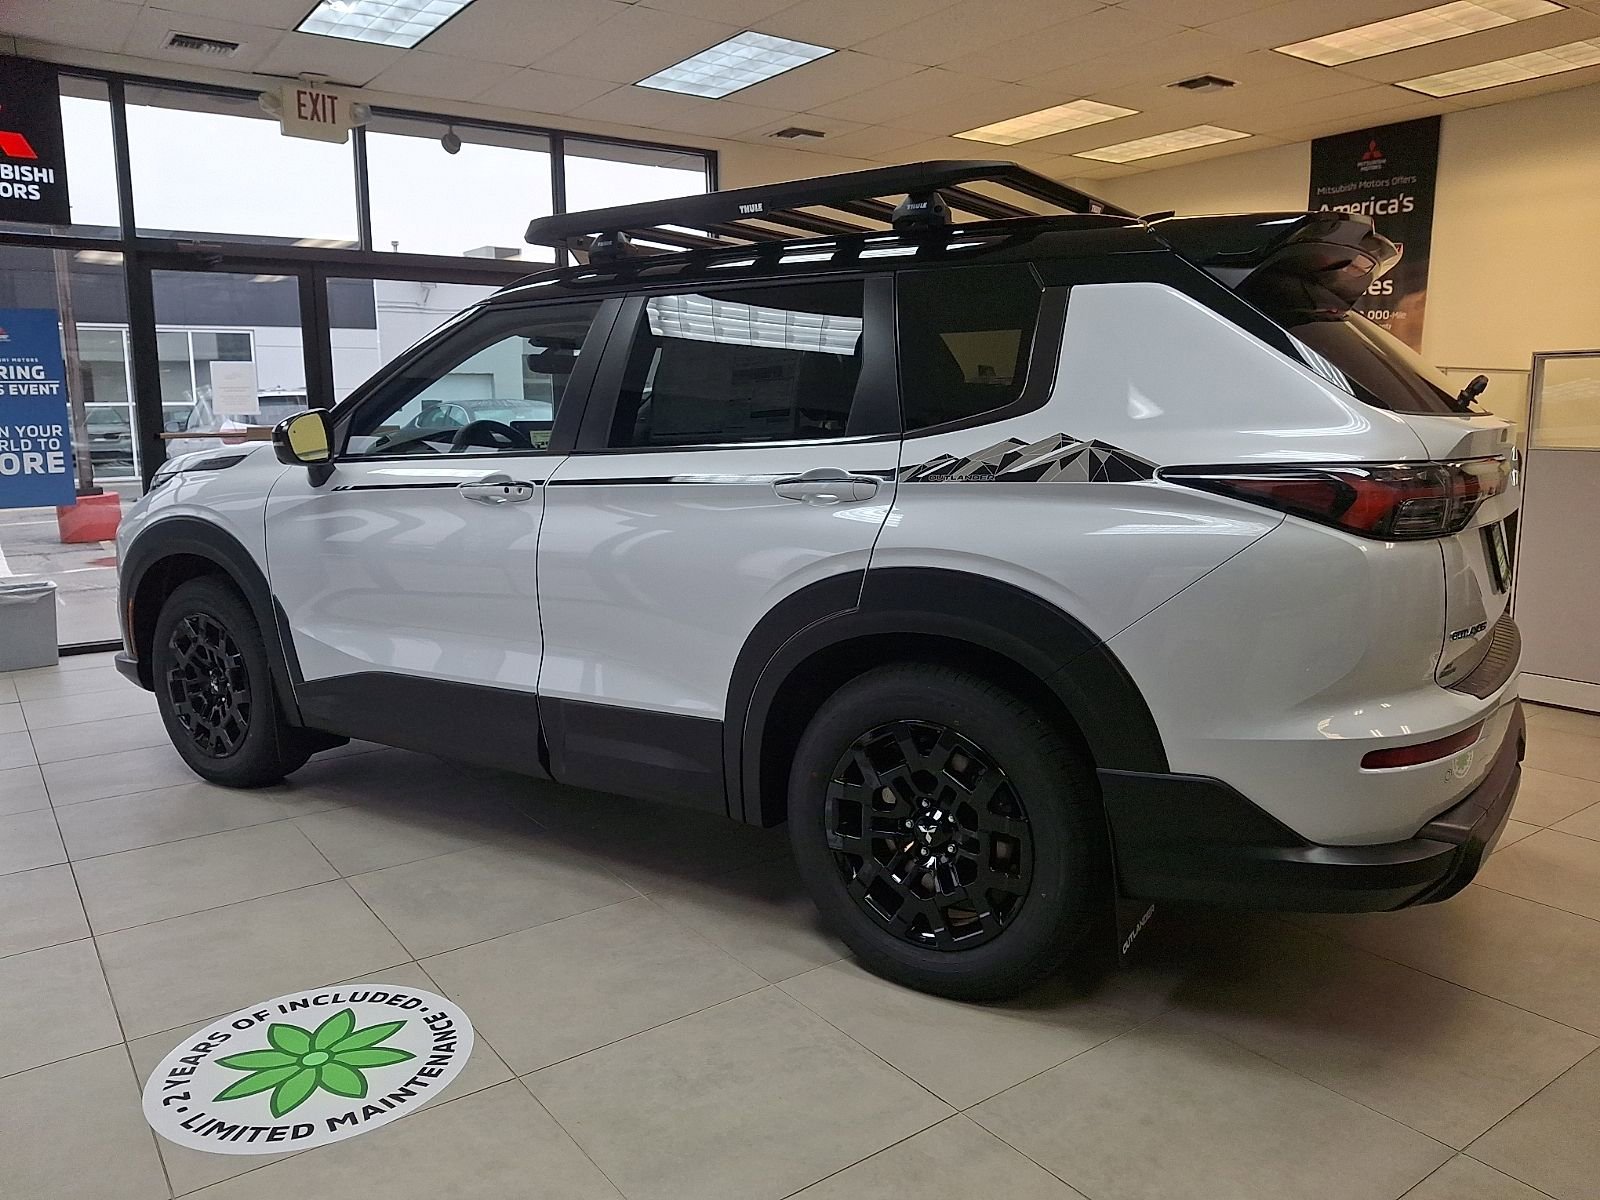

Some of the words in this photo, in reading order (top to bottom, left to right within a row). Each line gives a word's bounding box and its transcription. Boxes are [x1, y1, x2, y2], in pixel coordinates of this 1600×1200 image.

[297, 89, 338, 124] EXIT
[0, 163, 54, 184] BISHI
[0, 181, 41, 200] ORS
[1317, 183, 1357, 195] Mitsubishi
[1358, 179, 1390, 189] Motors
[739, 202, 763, 214] THULE
[906, 202, 928, 210] THULE
[1319, 192, 1414, 216] America's
[0, 365, 45, 380] RING
[9, 383, 60, 396] EVENT
[14, 424, 63, 438] YOUR
[0, 438, 32, 452] RLD
[36, 437, 60, 451] TO
[0, 451, 66, 476] ORE
[928, 474, 996, 482] OUTLANDER
[277, 991, 423, 1014] INCLUDED
[232, 1009, 271, 1030] OF
[166, 1031, 232, 1091] YEARS
[179, 1112, 315, 1143] LIMITED
[326, 1011, 458, 1132] MAINTENANCE
[163, 1092, 191, 1107] 2
